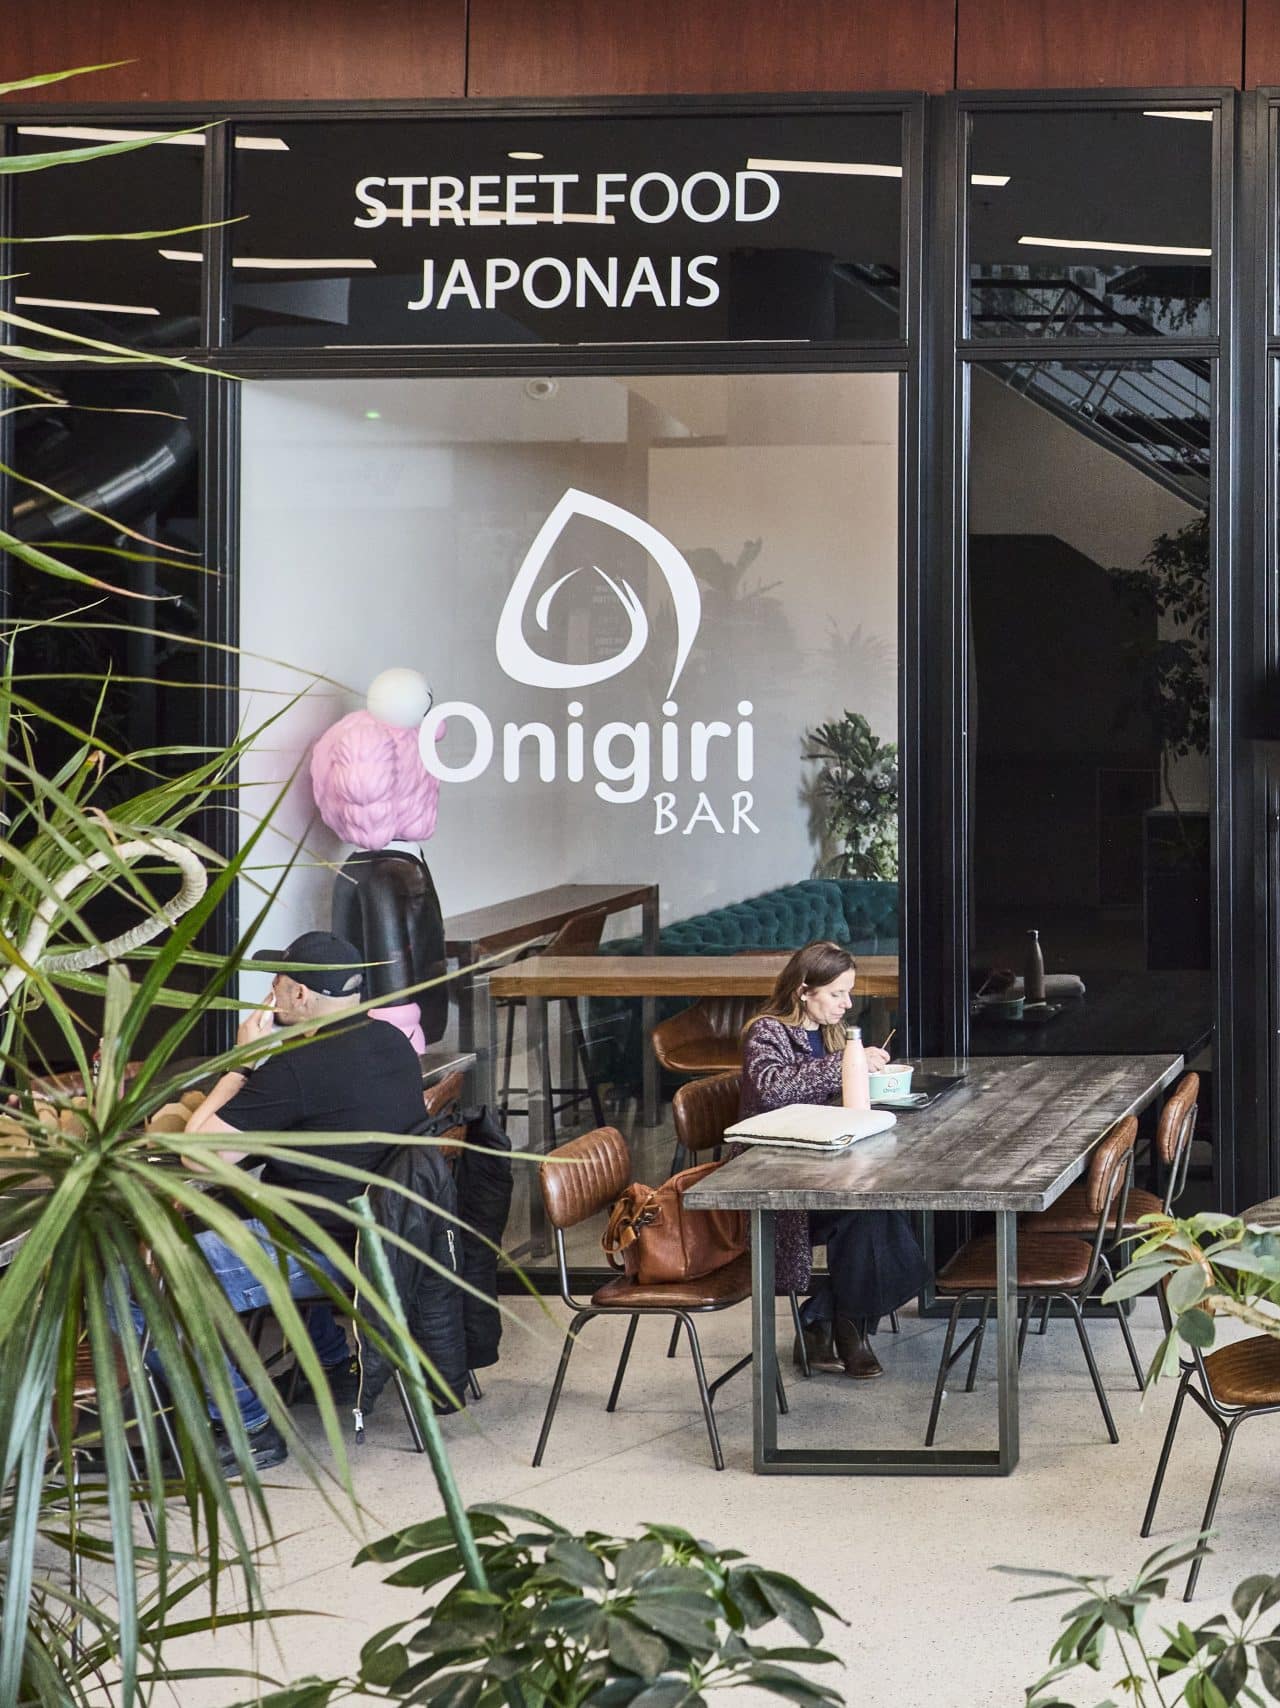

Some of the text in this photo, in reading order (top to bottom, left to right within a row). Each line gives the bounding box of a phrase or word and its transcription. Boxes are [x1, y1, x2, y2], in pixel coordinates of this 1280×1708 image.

[354, 170, 781, 229] STREET FOOD
[407, 255, 721, 311] JAPONAIS
[418, 700, 754, 804] Onigiri
[653, 790, 761, 836] BAR
